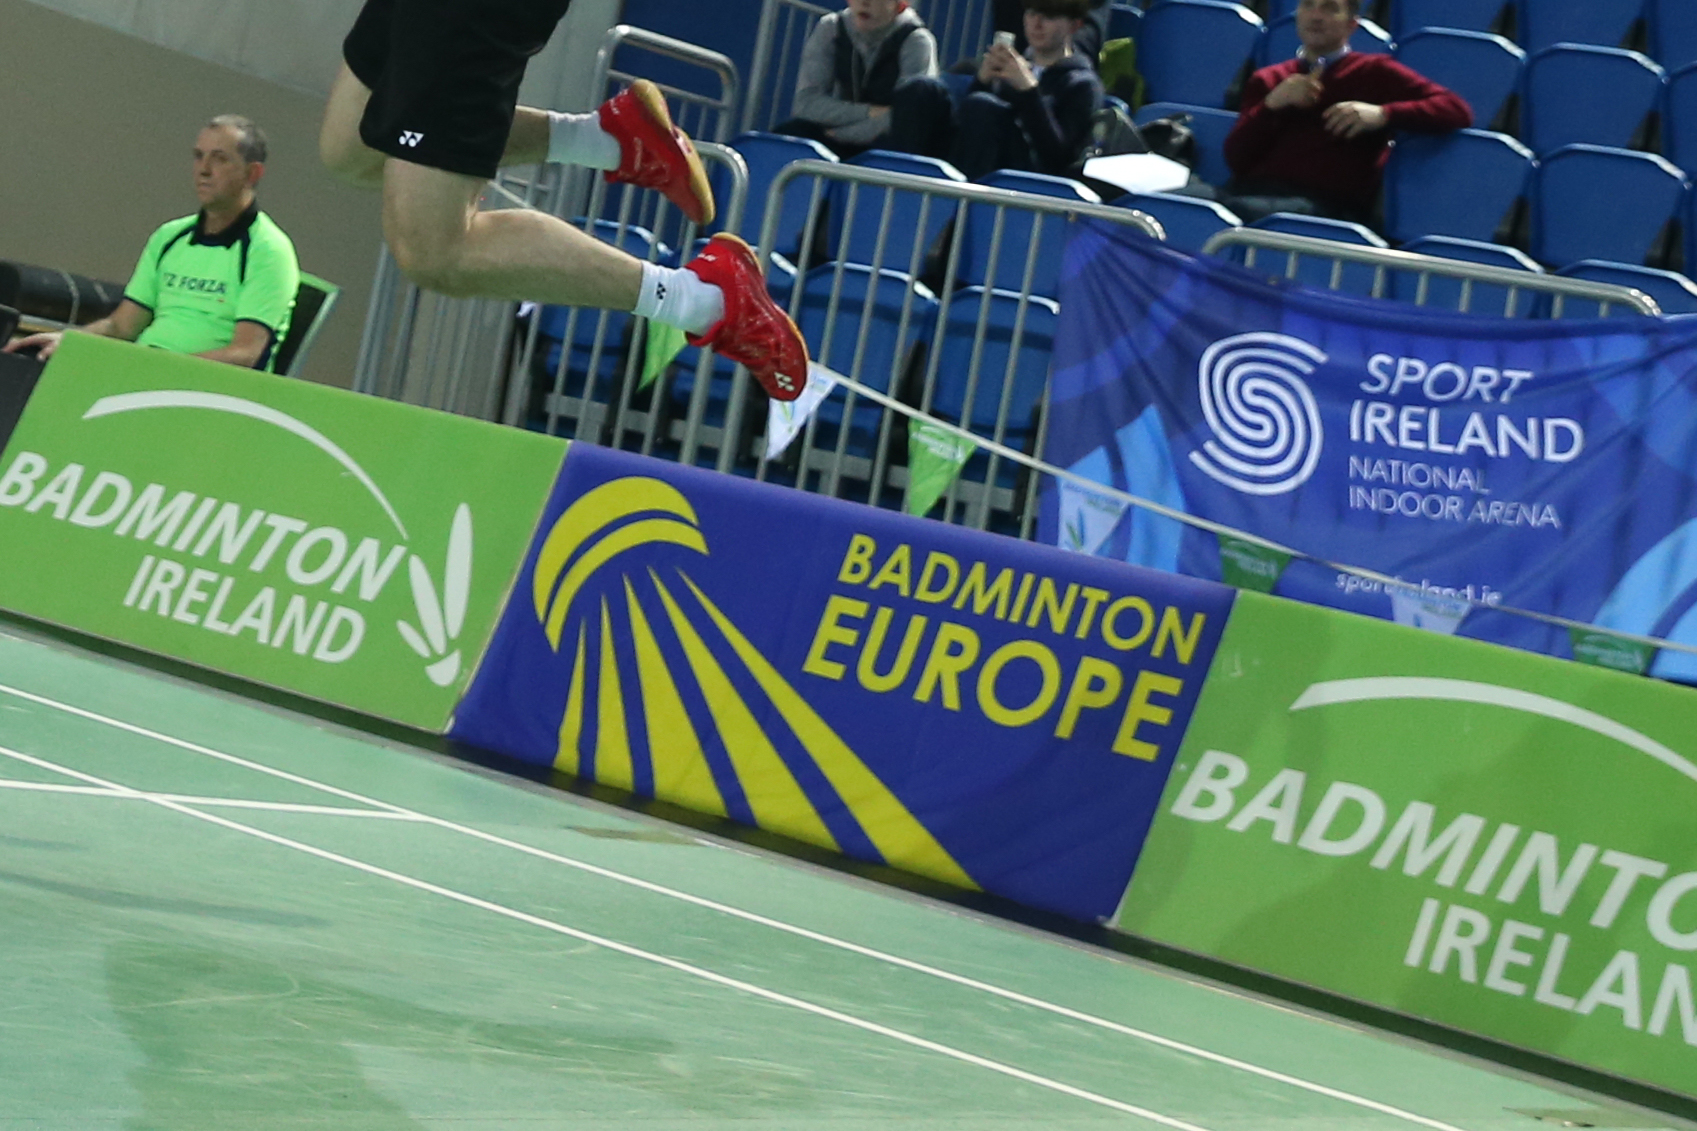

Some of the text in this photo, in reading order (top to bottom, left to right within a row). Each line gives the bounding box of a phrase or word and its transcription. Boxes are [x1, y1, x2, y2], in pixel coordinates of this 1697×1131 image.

[1359, 352, 1535, 404] SPORT
[1349, 398, 1585, 463] IRELAND
[1348, 455, 1491, 494] NATIONAL
[1348, 485, 1562, 529] INDOOR ARENA
[123, 555, 366, 665] IRELAND
[836, 533, 1206, 666] BADMINTON
[802, 595, 1186, 763] EUROPE
[1170, 748, 1697, 951] BADMINTO
